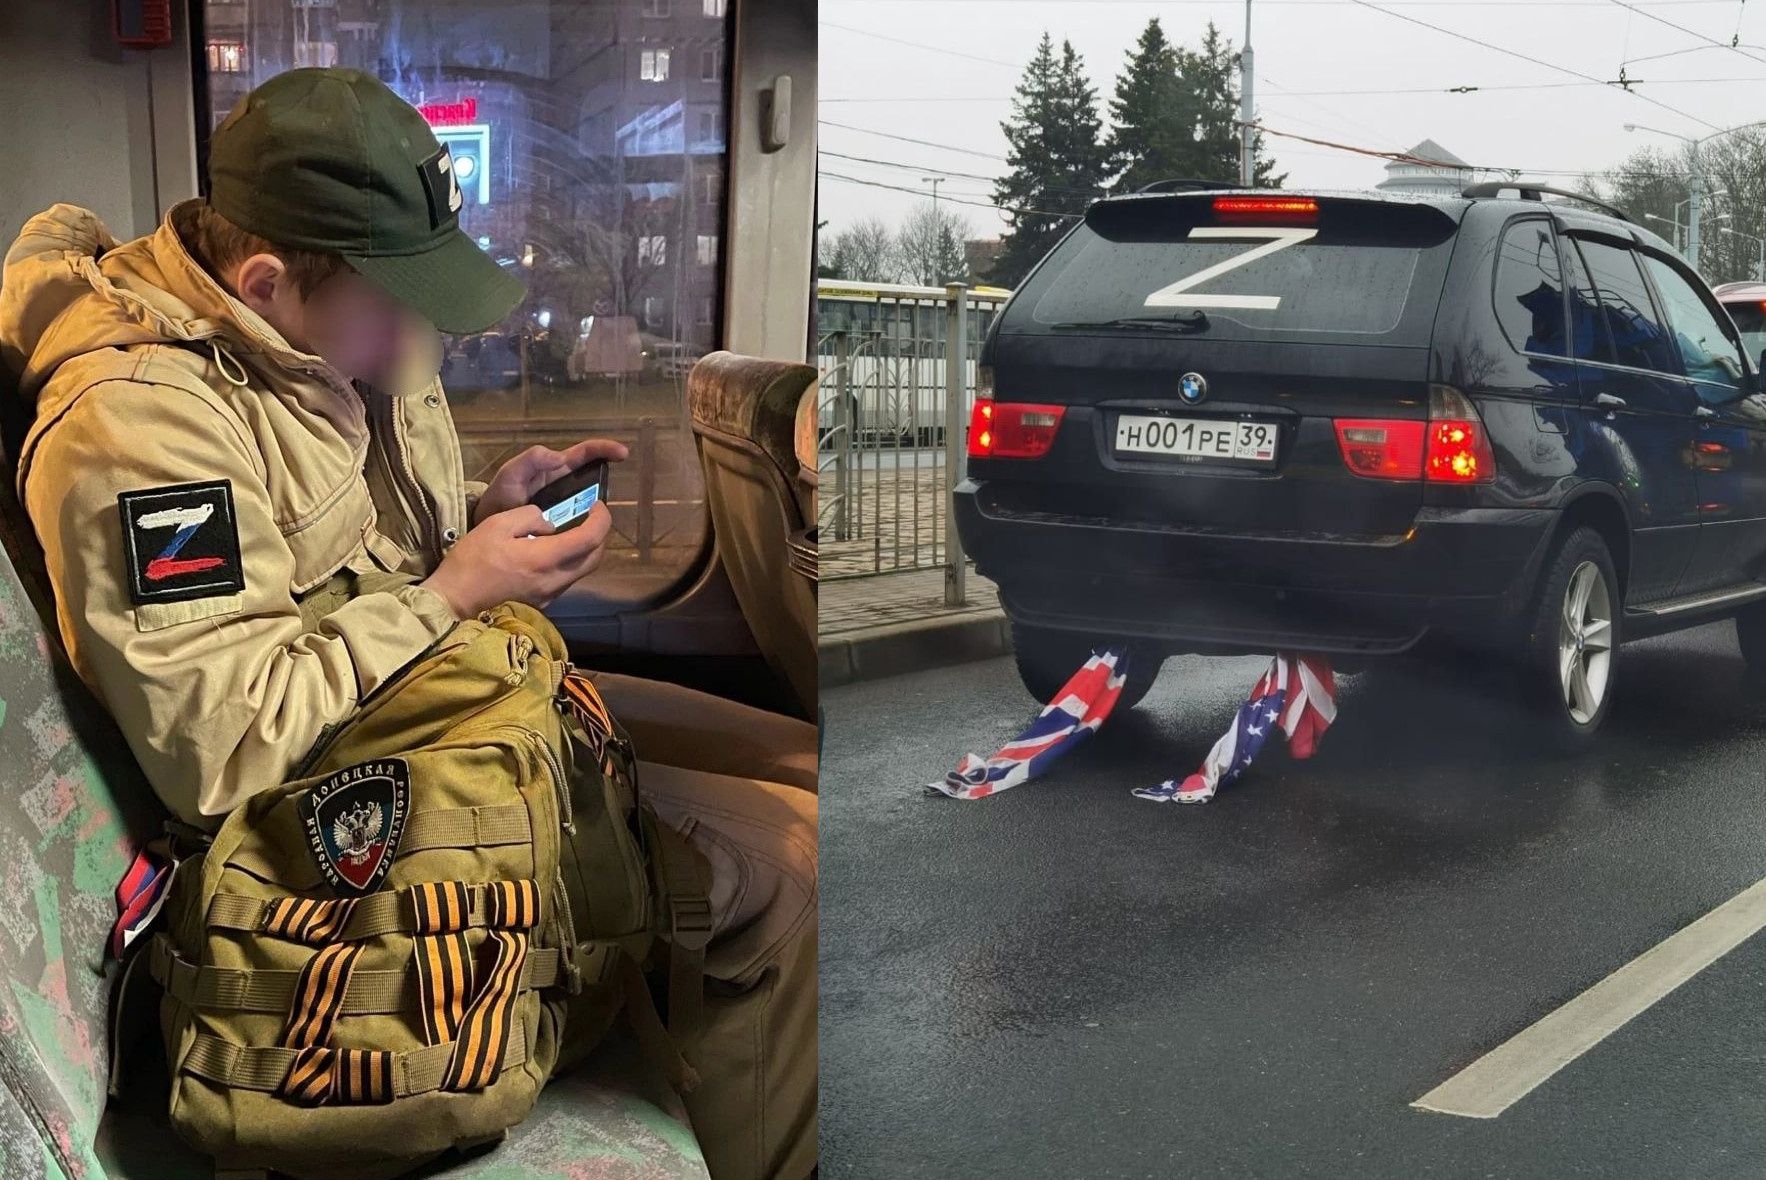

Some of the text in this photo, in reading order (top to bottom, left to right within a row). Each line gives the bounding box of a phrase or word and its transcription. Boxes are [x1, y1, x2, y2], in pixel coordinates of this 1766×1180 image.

[438, 152, 461, 212] Z
[1144, 227, 1319, 310] Z
[1237, 446, 1256, 456] RUS
[1239, 425, 1267, 447] 39
[136, 503, 226, 580] Z
